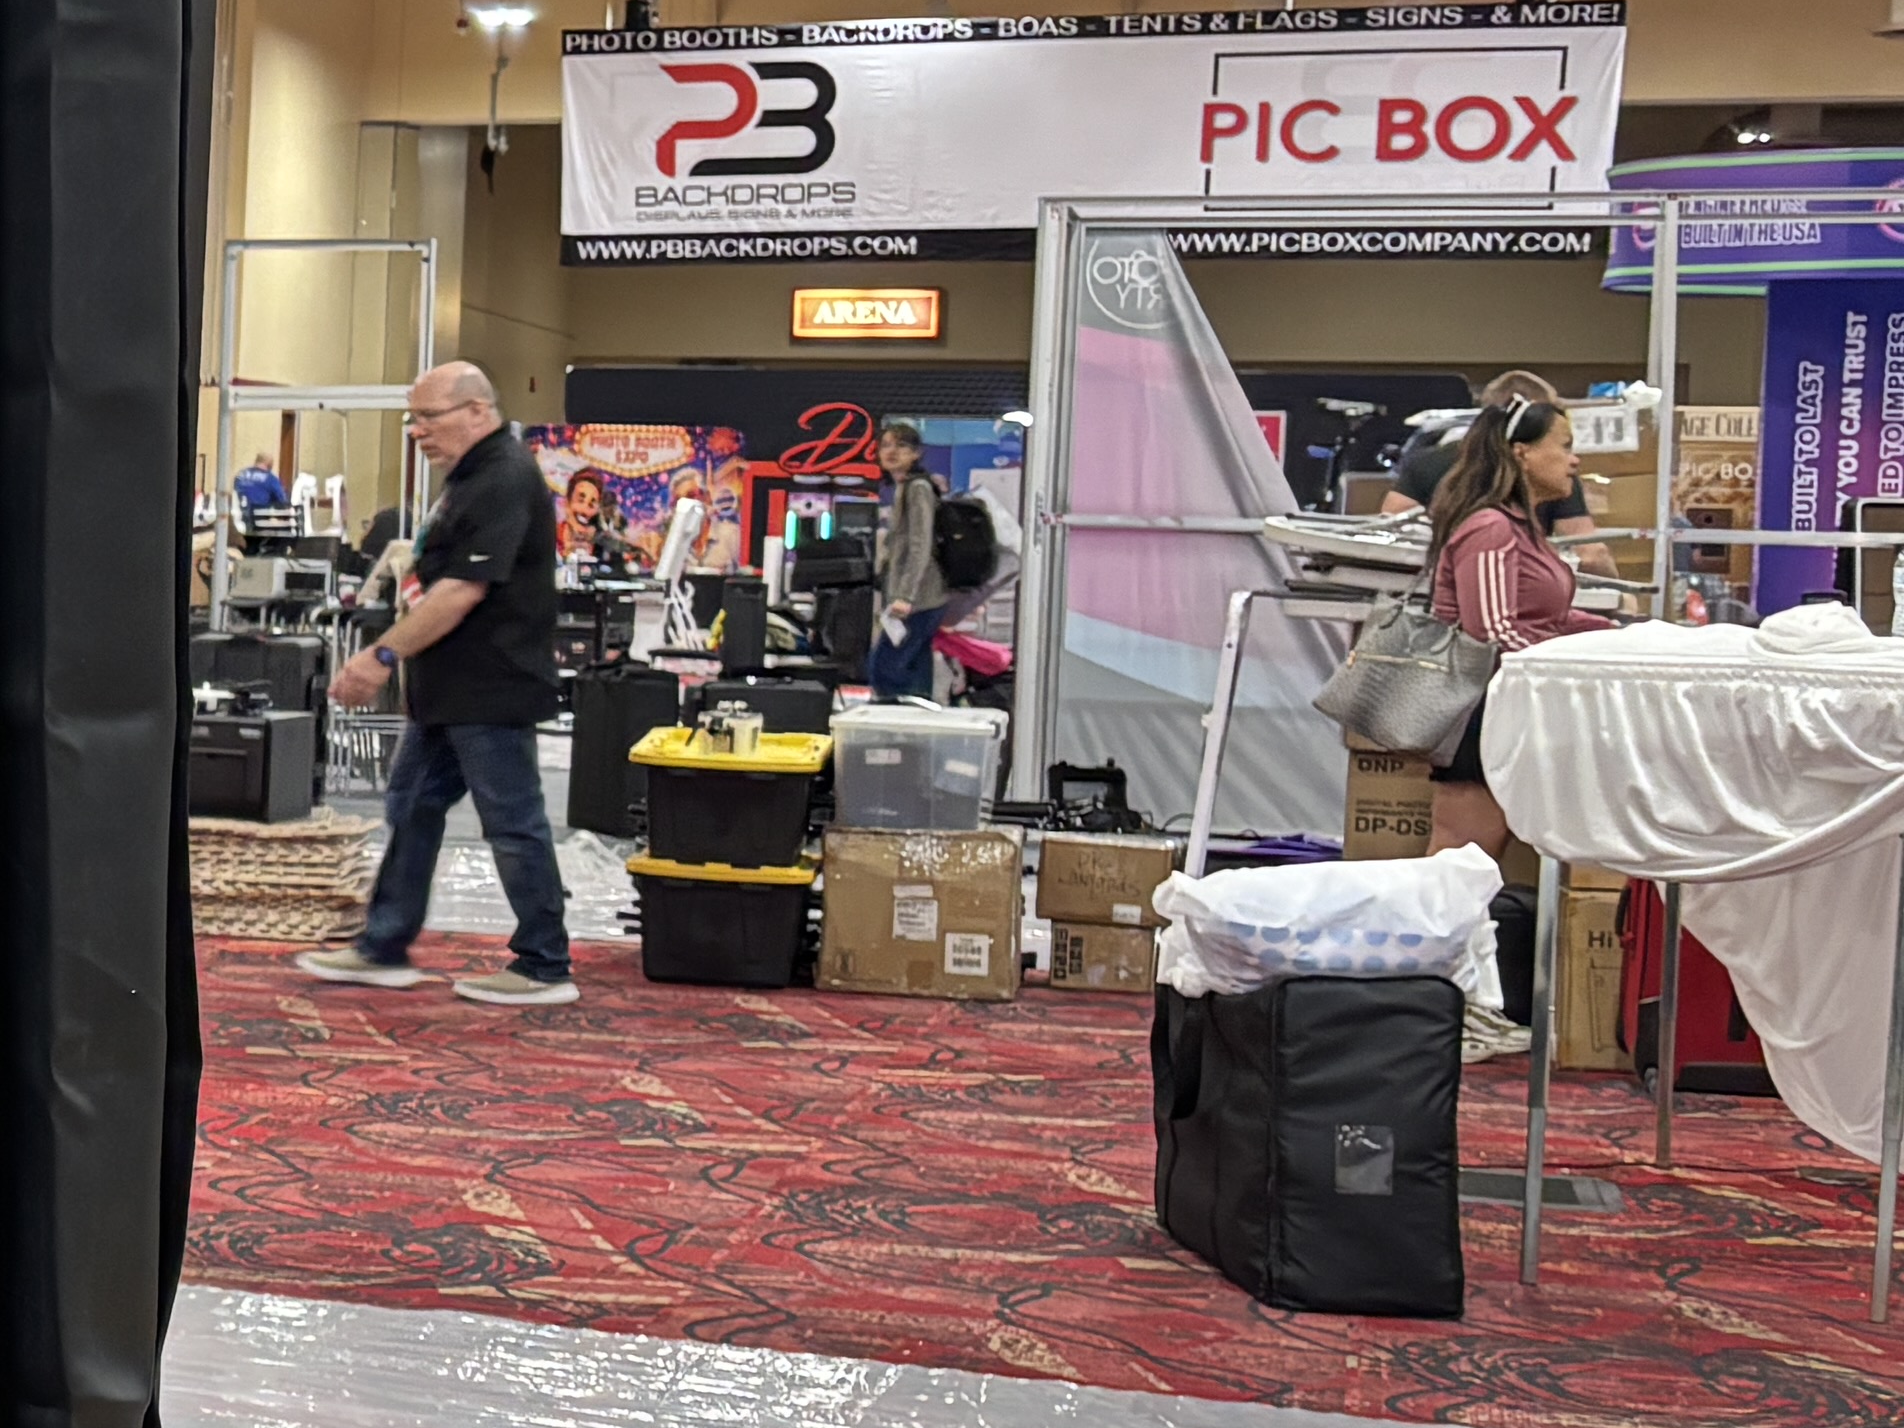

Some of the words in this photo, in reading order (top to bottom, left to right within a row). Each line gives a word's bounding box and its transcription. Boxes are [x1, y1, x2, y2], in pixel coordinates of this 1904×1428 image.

[565, 30, 657, 52] PHOTO
[663, 26, 779, 48] BOOTHS
[802, 18, 974, 45] BACKDROPS
[998, 16, 1078, 38] BOAS
[1103, 13, 1202, 34] TENTS
[1209, 13, 1229, 32] &
[1237, 10, 1338, 31] FLAGS
[1366, 6, 1464, 27] SIGNS
[1490, 5, 1512, 24] &
[1519, 3, 1621, 23] MORE!
[1200, 99, 1341, 164] PIC
[1375, 94, 1579, 163] BOX
[635, 181, 856, 207] BACKDROPS
[578, 235, 917, 260] WWW.PBBACKDROPS.COM
[813, 301, 917, 325] ARENA
[1843, 311, 1868, 384] TRUST
[1795, 361, 1825, 424] LAST
[1840, 387, 1863, 435] CAN
[1794, 425, 1820, 462] TO
[1879, 423, 1904, 460] TO
[1720, 462, 1754, 480] BO
[1837, 439, 1859, 489] YOU
[1792, 463, 1819, 532] BUILT
[1355, 816, 1430, 836] DP-DS
